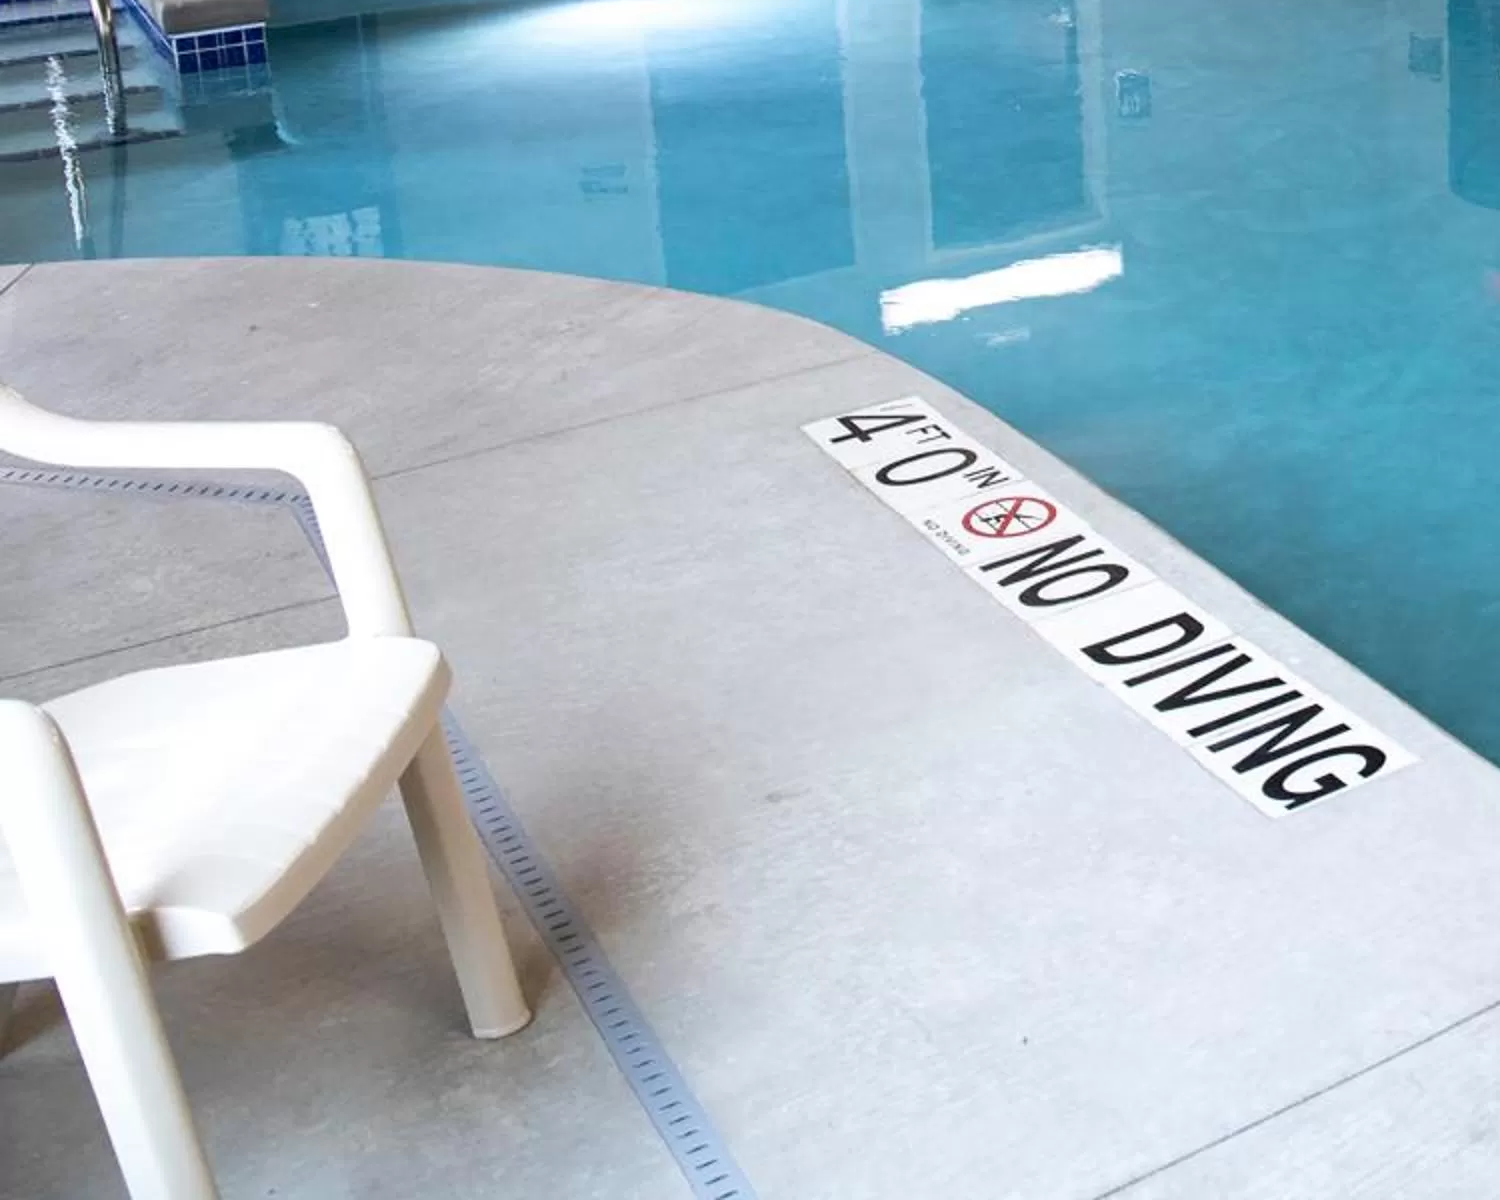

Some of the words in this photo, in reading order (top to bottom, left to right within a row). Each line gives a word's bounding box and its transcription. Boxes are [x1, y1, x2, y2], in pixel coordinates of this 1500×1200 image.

[829, 415, 928, 443] 4
[905, 423, 952, 444] FT
[875, 447, 978, 486] 0
[963, 465, 1010, 488] IN
[979, 534, 1129, 607] NO
[1080, 611, 1387, 810] DIVING
